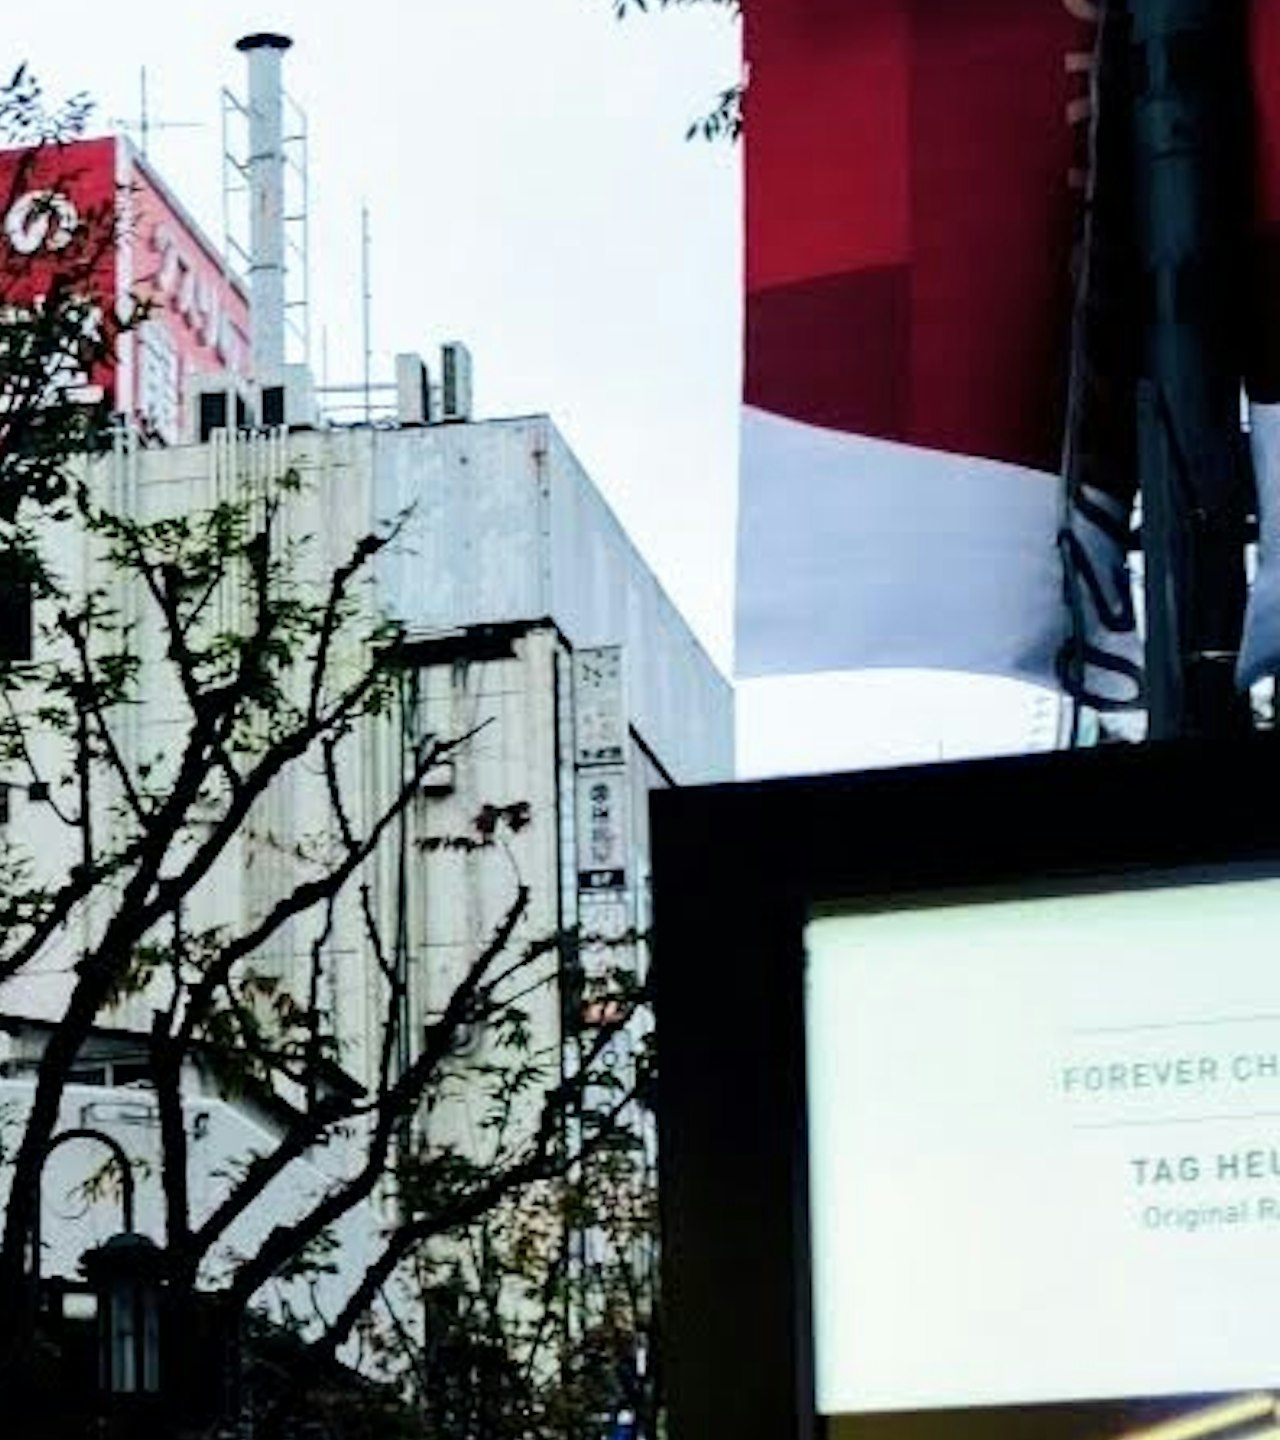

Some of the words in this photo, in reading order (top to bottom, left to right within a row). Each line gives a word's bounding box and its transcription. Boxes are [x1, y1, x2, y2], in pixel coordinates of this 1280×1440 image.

[1062, 1056, 1219, 1093] FOREVER
[1129, 1155, 1200, 1187] TAG
[1143, 1201, 1248, 1233] Original
